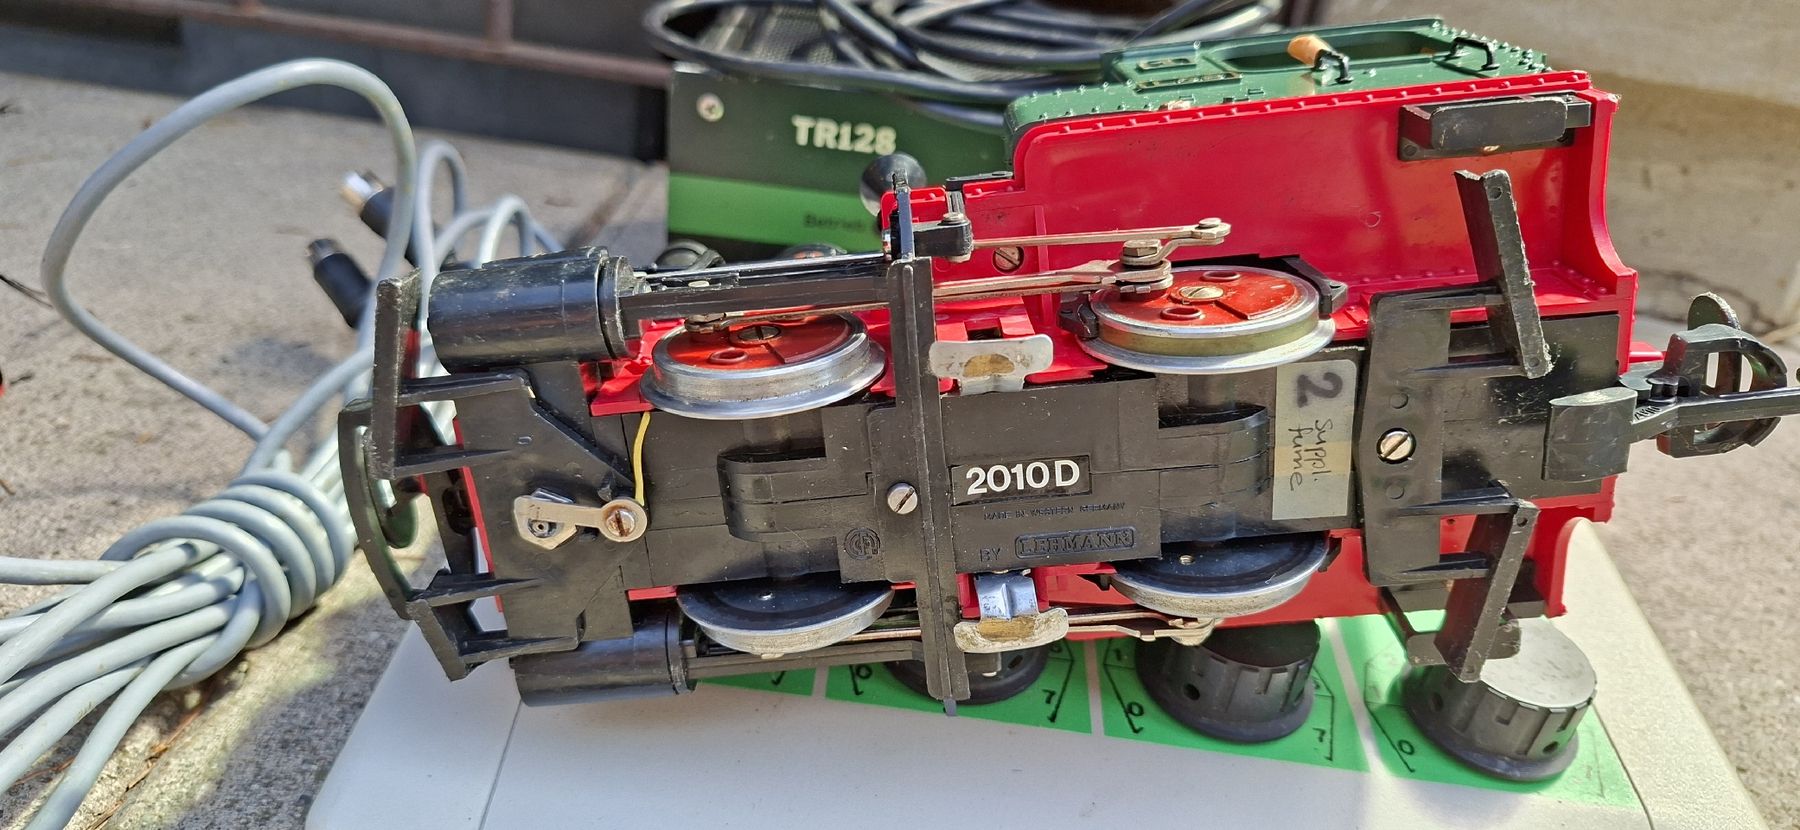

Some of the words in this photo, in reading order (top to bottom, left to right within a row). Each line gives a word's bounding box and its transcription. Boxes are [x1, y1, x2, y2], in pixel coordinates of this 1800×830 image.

[791, 114, 897, 155] TR128
[1296, 371, 1343, 409] 2
[1079, 502, 1126, 513] GERMANY
[979, 547, 1000, 562] BY
[1019, 530, 1132, 556] LEHMANN
[1397, 739, 1416, 756] 0
